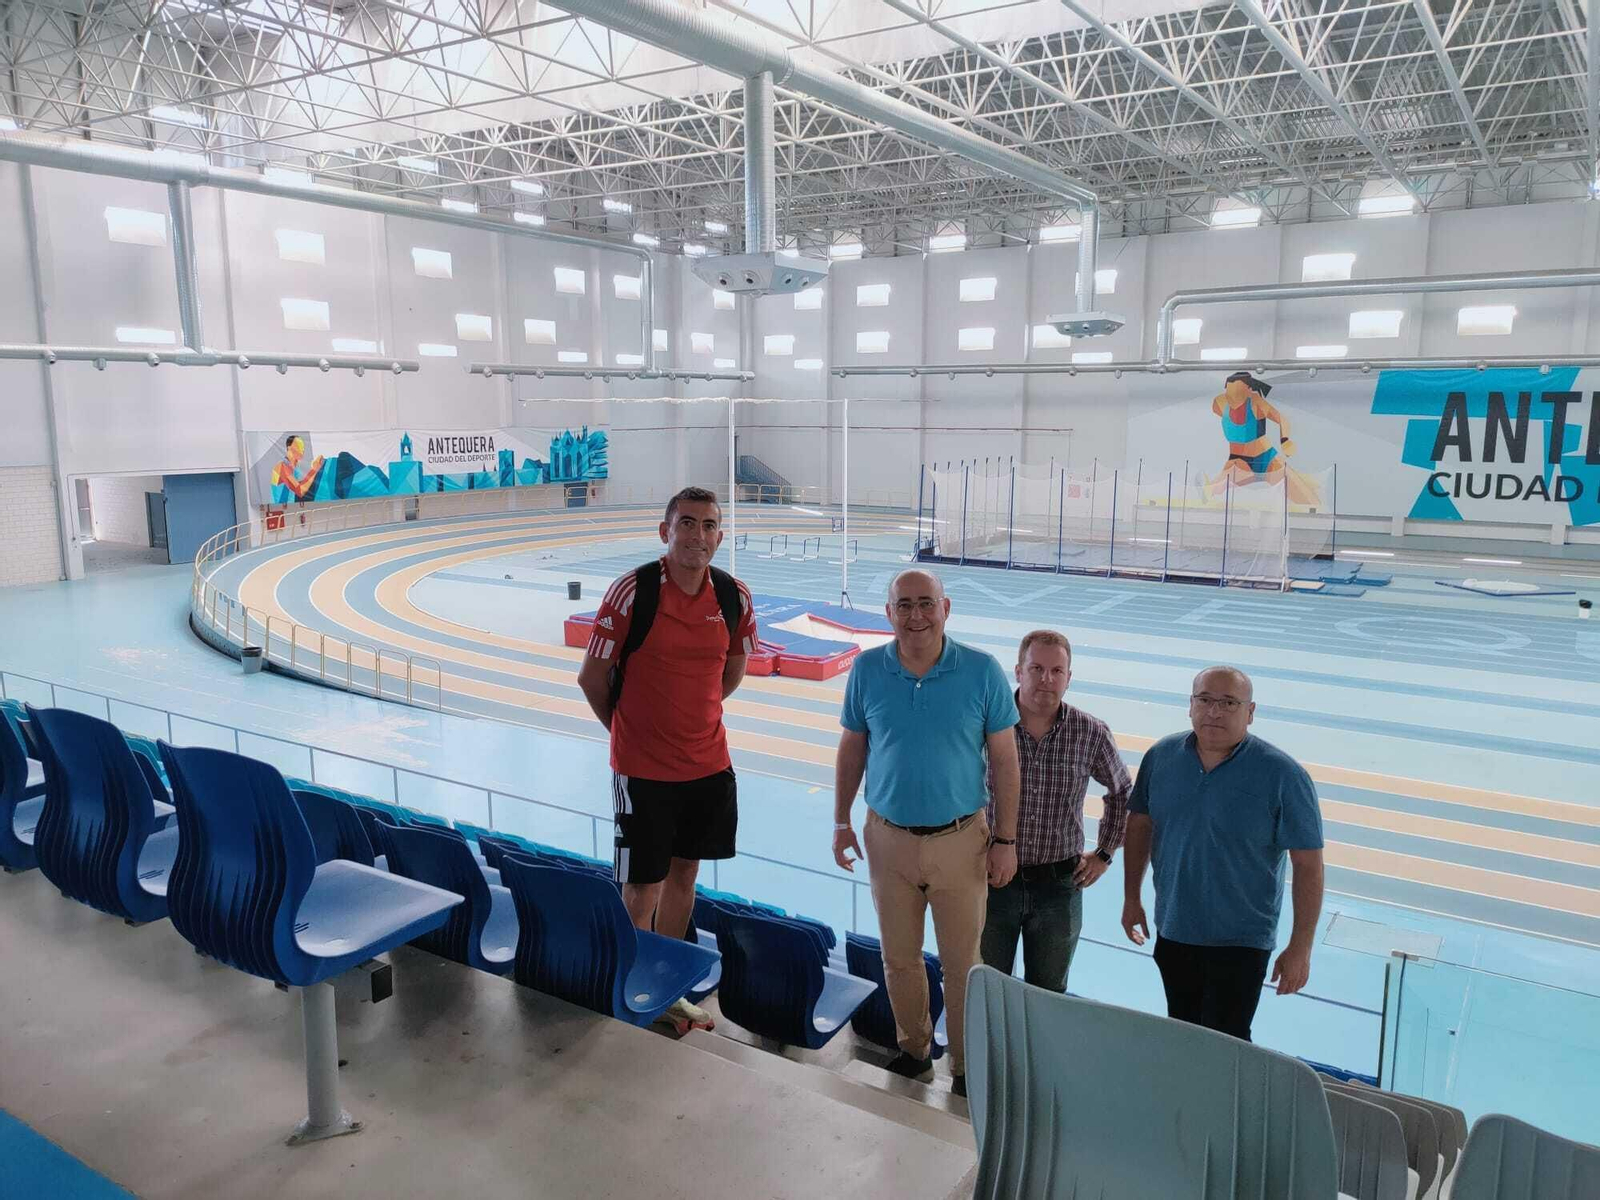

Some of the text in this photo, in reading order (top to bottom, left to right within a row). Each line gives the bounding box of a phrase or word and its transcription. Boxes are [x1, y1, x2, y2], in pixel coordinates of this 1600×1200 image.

[428, 436, 495, 455] ANTEQUERA
[428, 454, 496, 464] CIUDAD DEL DEPORTE
[1427, 471, 1585, 503] CIUDAD
